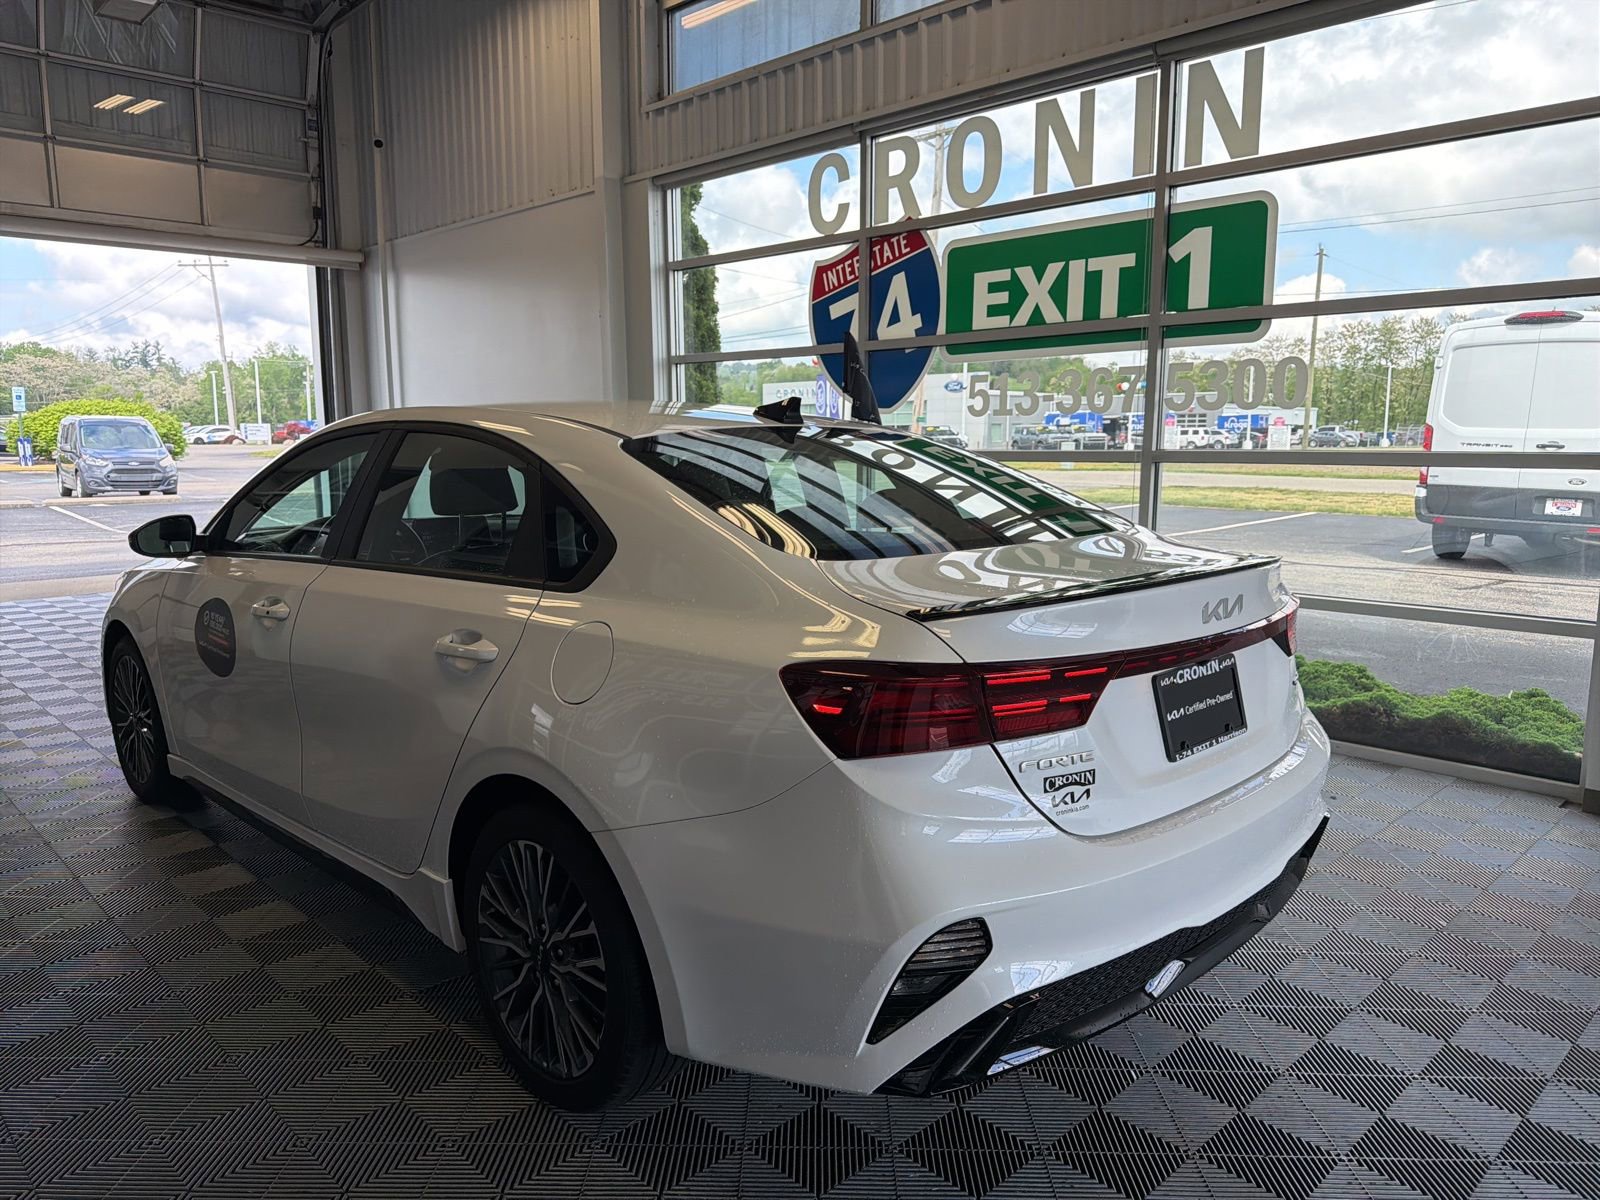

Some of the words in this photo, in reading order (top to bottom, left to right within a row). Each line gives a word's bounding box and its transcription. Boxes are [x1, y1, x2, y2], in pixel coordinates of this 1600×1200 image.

[808, 46, 1265, 235] CRONIN
[823, 233, 910, 292] INTERTATE
[972, 253, 1137, 331] EXIT
[1168, 226, 1213, 310] 1
[829, 271, 923, 353] 74
[967, 356, 1309, 418] 513-3675300
[1224, 417, 1250, 433] Kroge
[1201, 594, 1244, 625] KIA
[1176, 659, 1220, 684] CRONIN
[1185, 699, 1207, 715] Certified
[1206, 690, 1233, 707] Pre-Owned
[1218, 727, 1247, 743] Harrison
[1018, 750, 1095, 773] FORTE
[1045, 770, 1094, 792] CRONIN
[1055, 804, 1090, 817] croninkia.com
